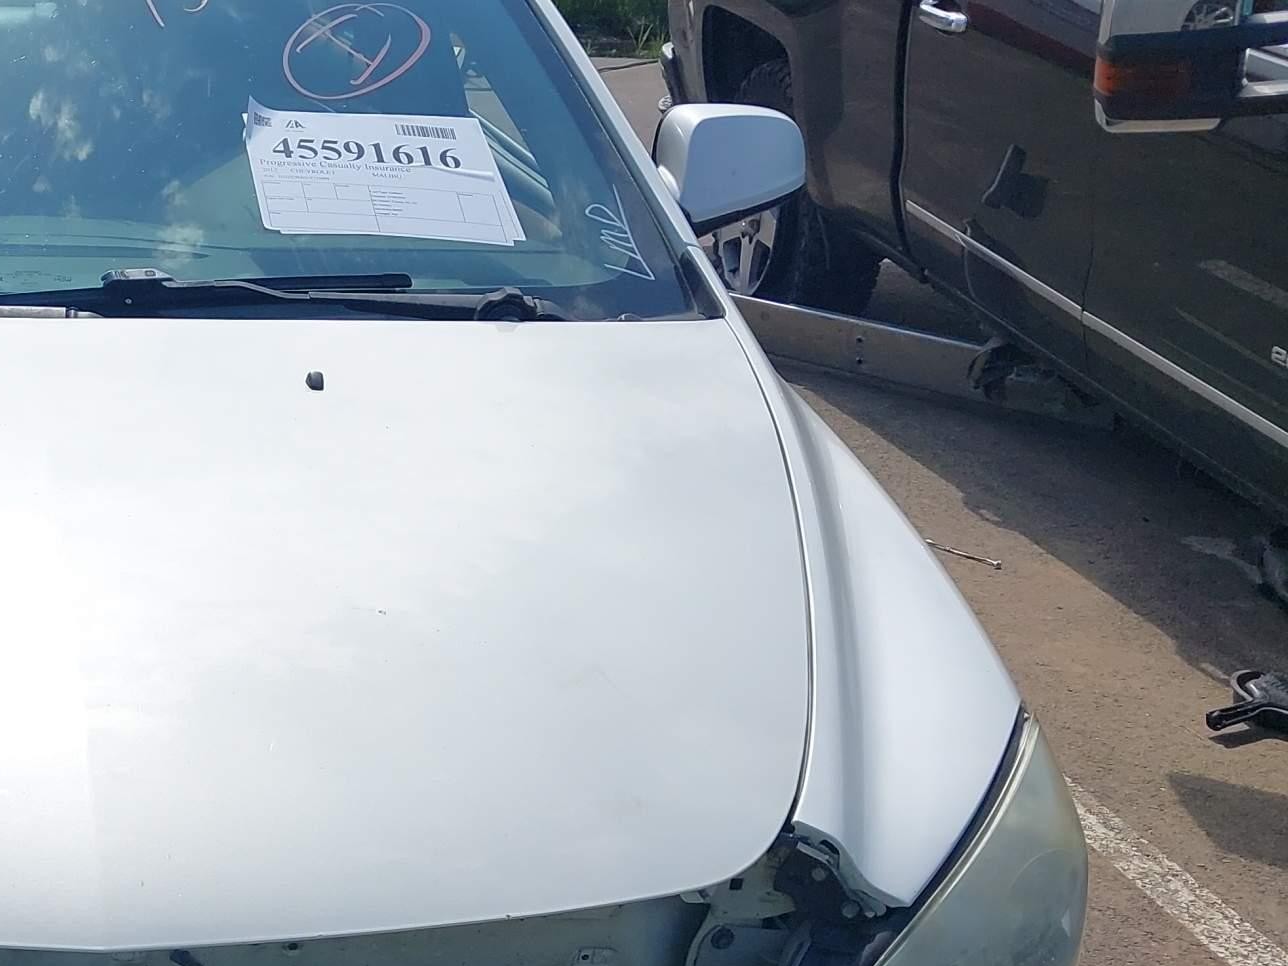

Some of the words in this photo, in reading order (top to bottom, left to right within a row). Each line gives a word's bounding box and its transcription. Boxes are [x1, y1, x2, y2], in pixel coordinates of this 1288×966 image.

[272, 137, 462, 169] 45591616
[259, 159, 317, 169] Progressive
[319, 160, 362, 171] Casualty
[365, 164, 412, 174] Insurance
